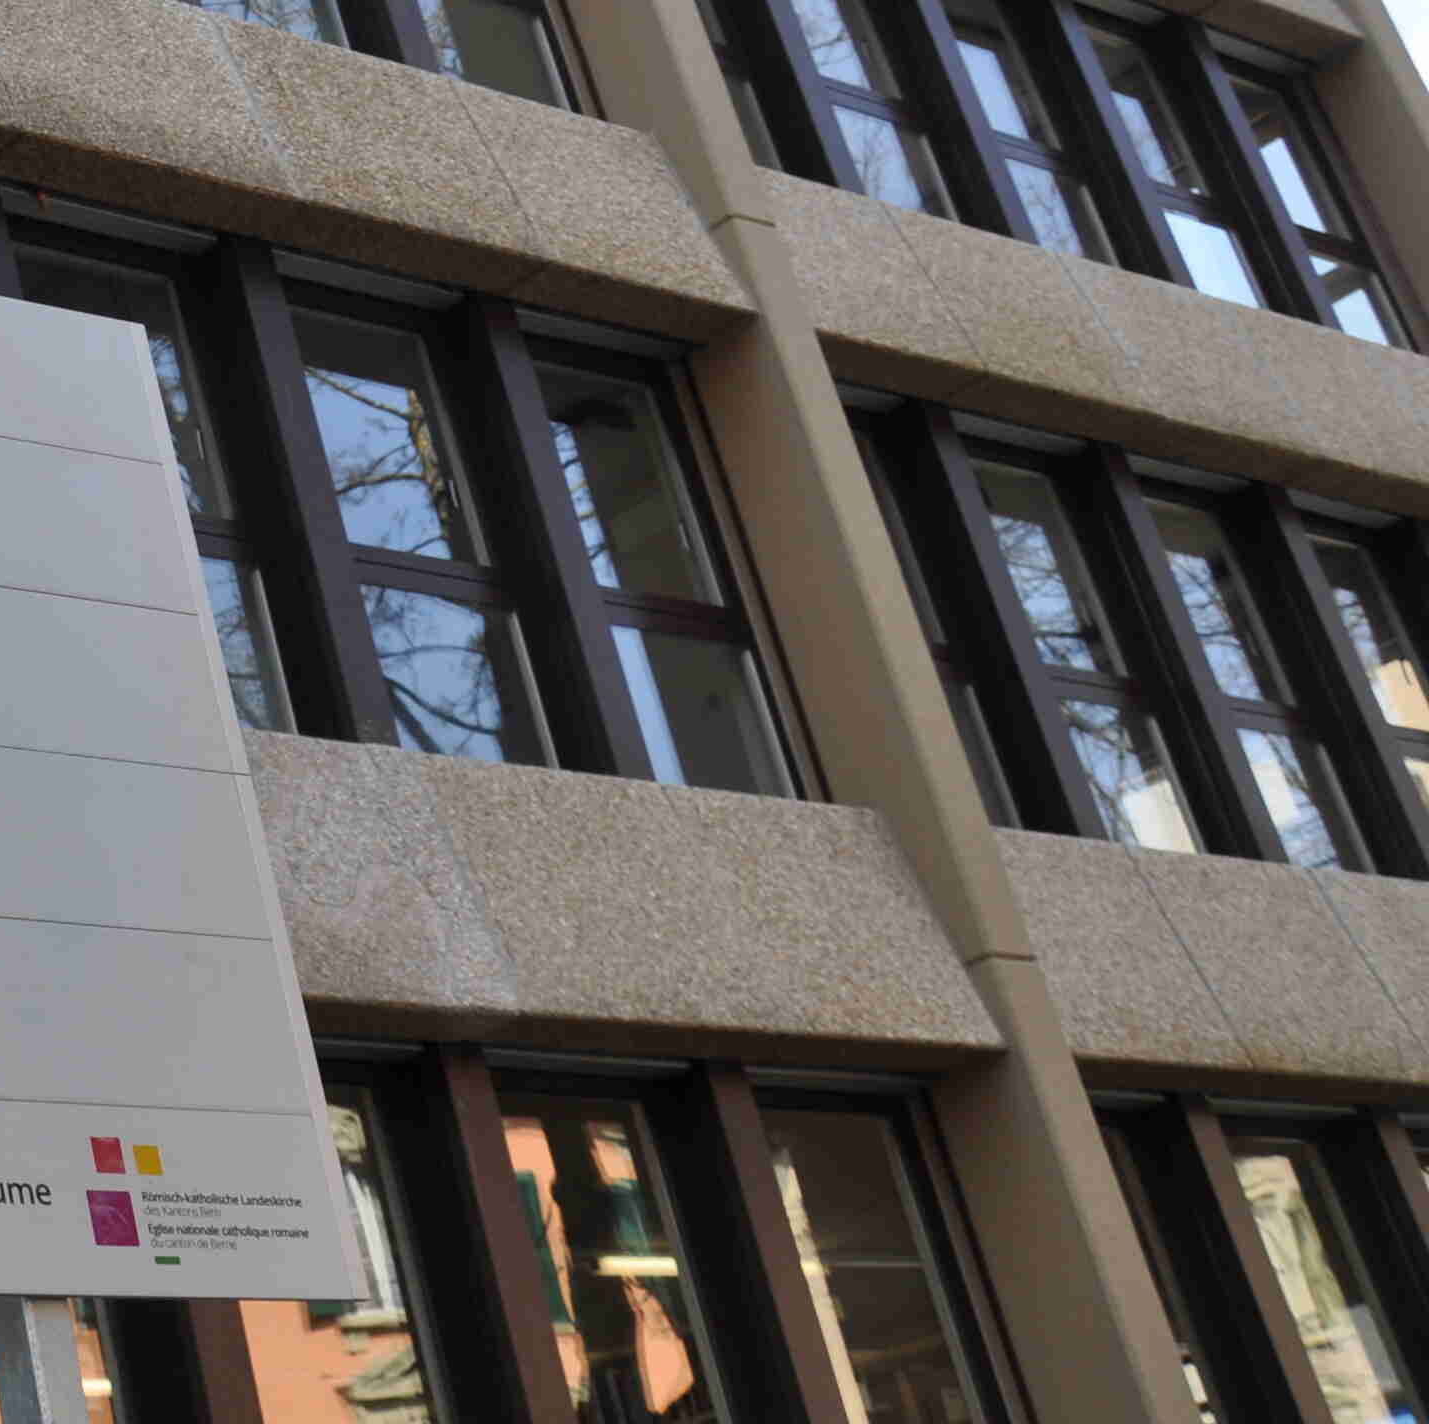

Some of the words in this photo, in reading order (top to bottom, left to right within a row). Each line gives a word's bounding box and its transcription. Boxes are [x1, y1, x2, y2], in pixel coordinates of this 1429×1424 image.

[141, 1191, 238, 1205] Römisch-katholische
[240, 1194, 302, 1207] Landeskirche
[176, 1224, 221, 1236] nationale
[222, 1226, 269, 1240] catholique
[271, 1228, 309, 1239] romaine
